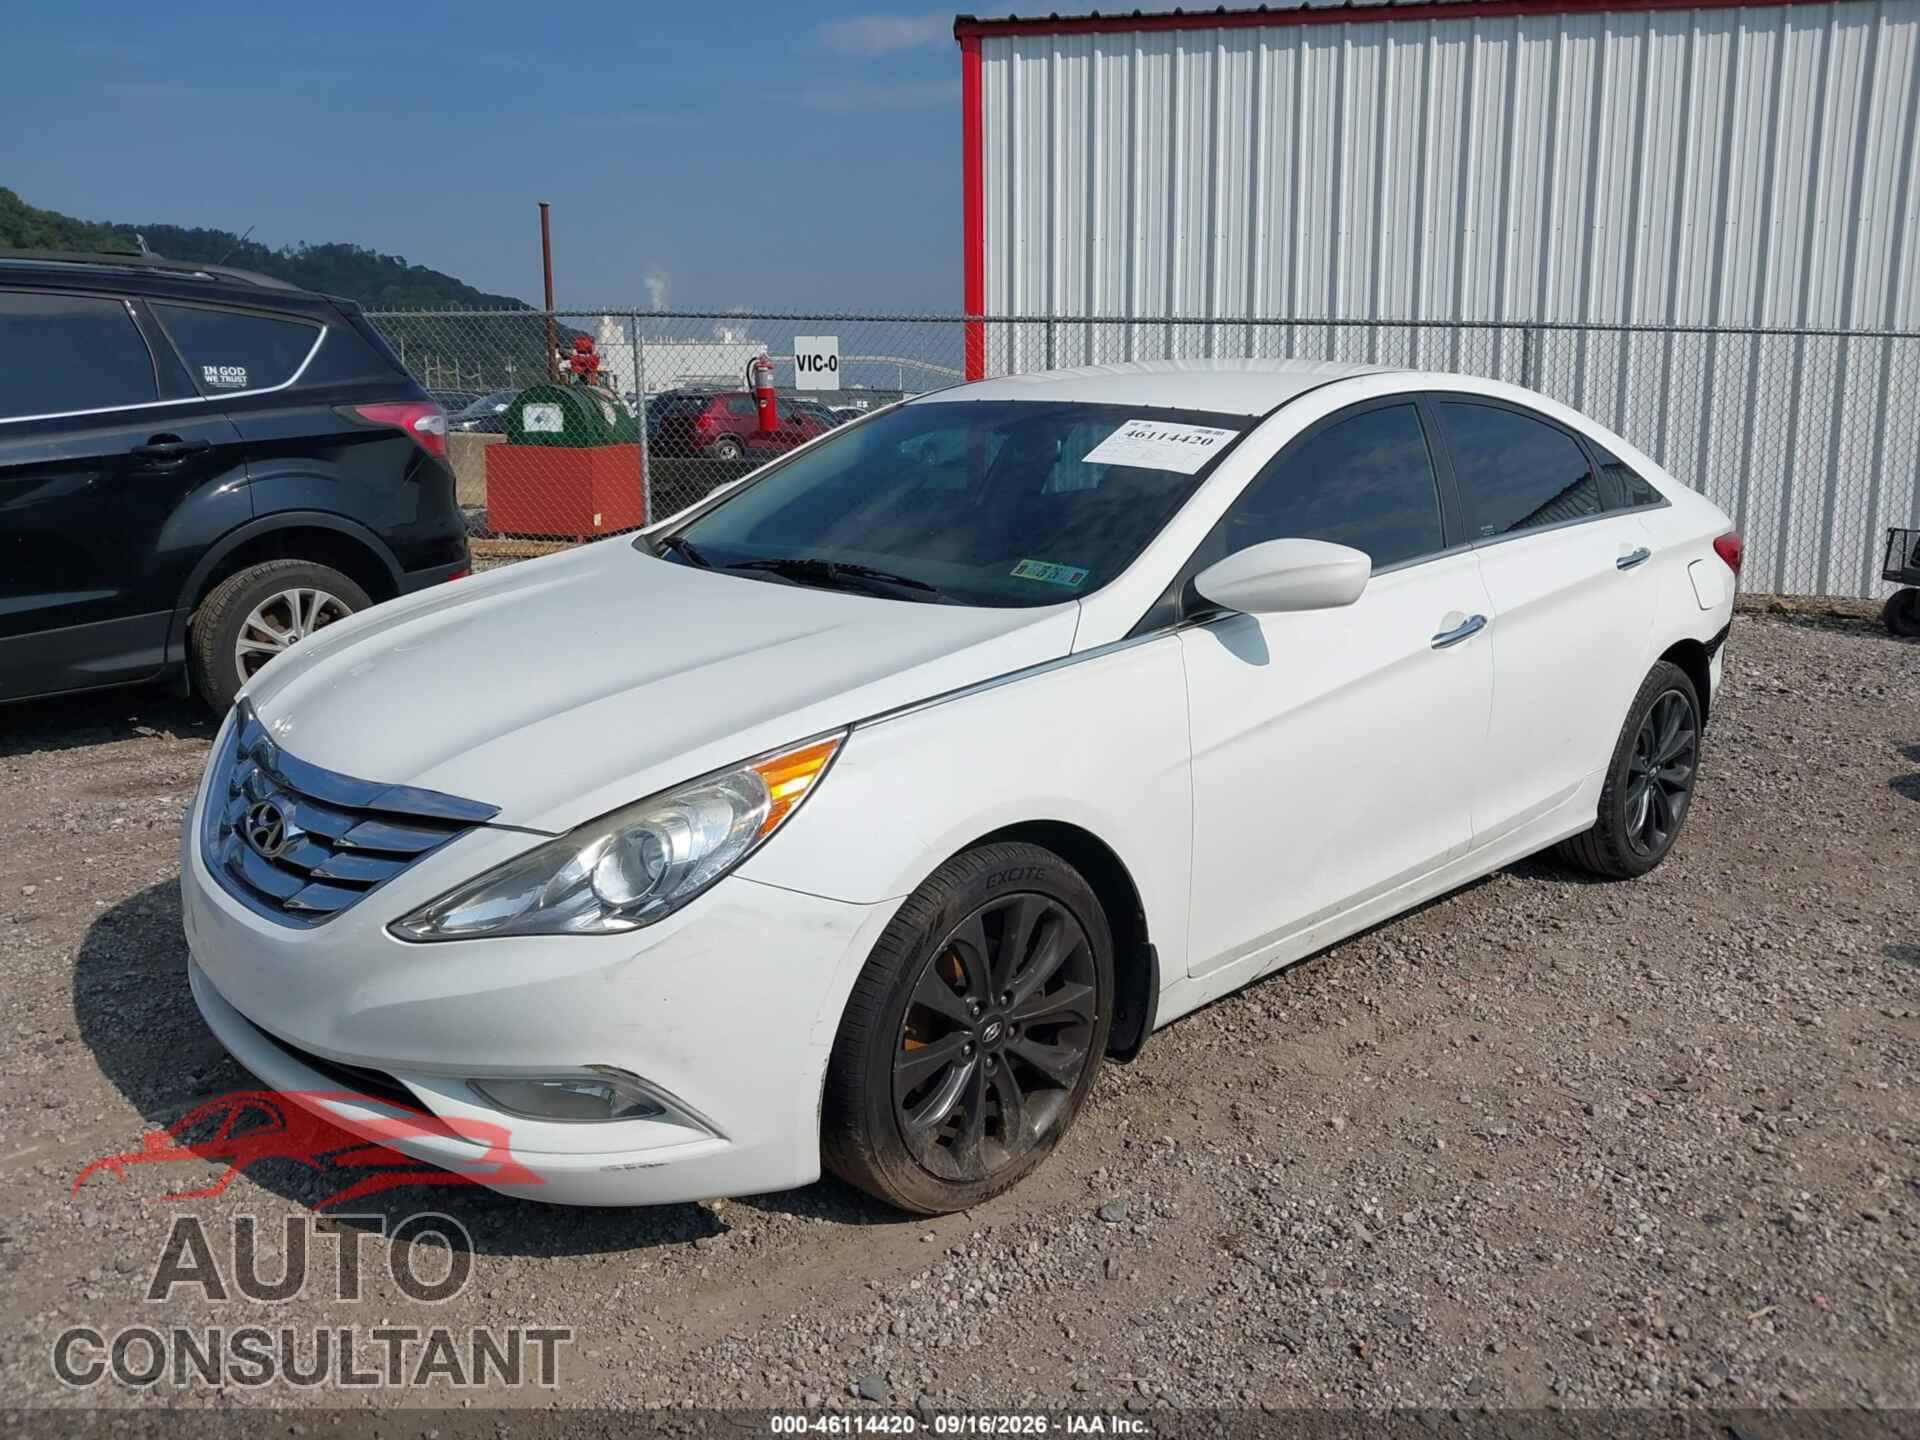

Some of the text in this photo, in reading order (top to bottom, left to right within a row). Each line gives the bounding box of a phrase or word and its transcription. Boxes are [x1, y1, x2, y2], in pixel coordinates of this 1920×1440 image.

[203, 366, 246, 375] IN GOD
[204, 375, 247, 383] WE TRUST
[1124, 429, 1215, 447] 46114420
[986, 866, 1047, 889] EXCITE
